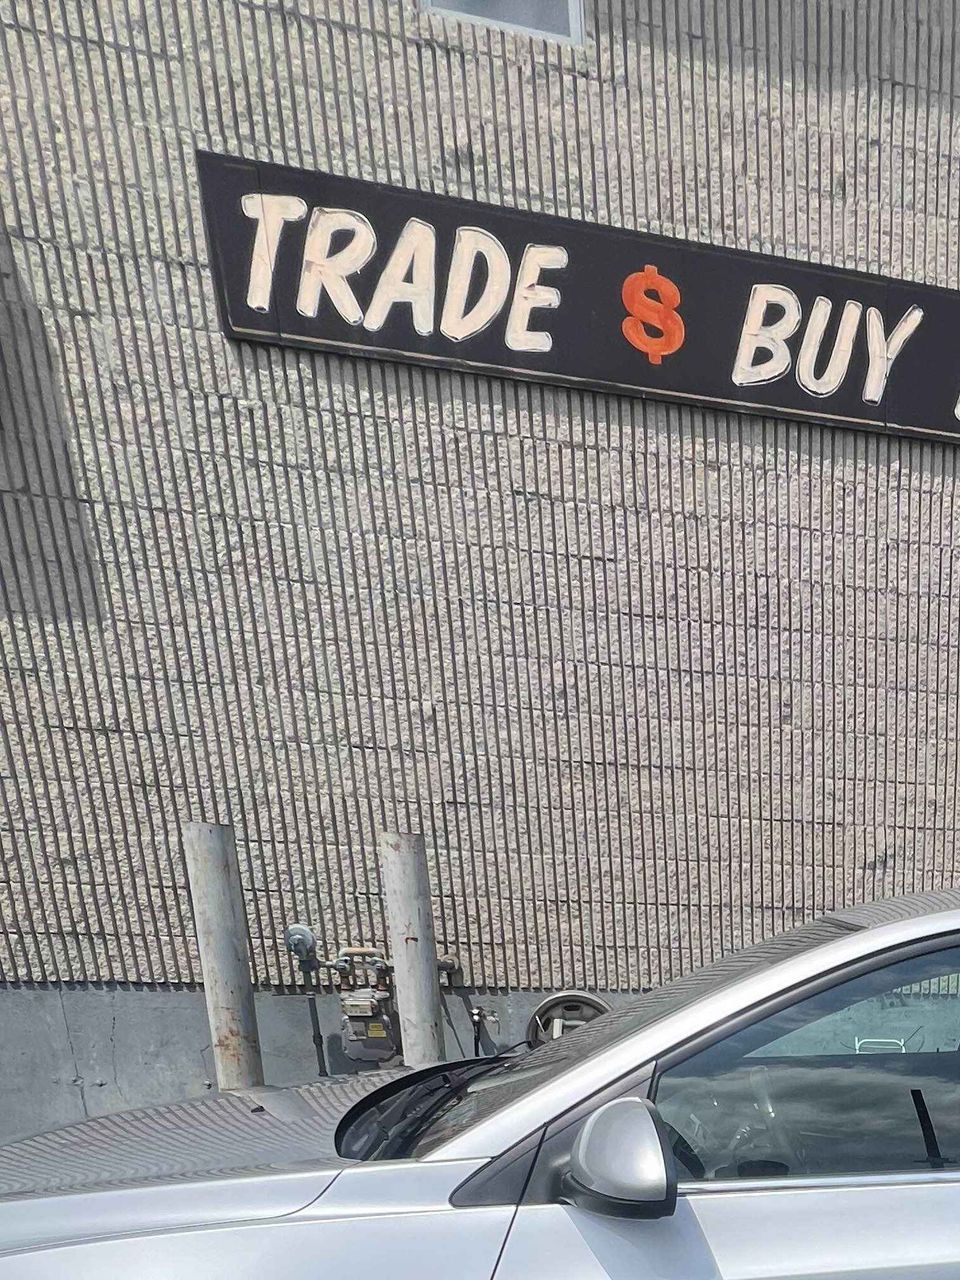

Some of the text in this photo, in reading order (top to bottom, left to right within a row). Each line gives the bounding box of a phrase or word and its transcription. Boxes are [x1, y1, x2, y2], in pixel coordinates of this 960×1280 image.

[241, 192, 569, 352] TRADE
[621, 264, 686, 365] $
[731, 283, 925, 406] BUY
